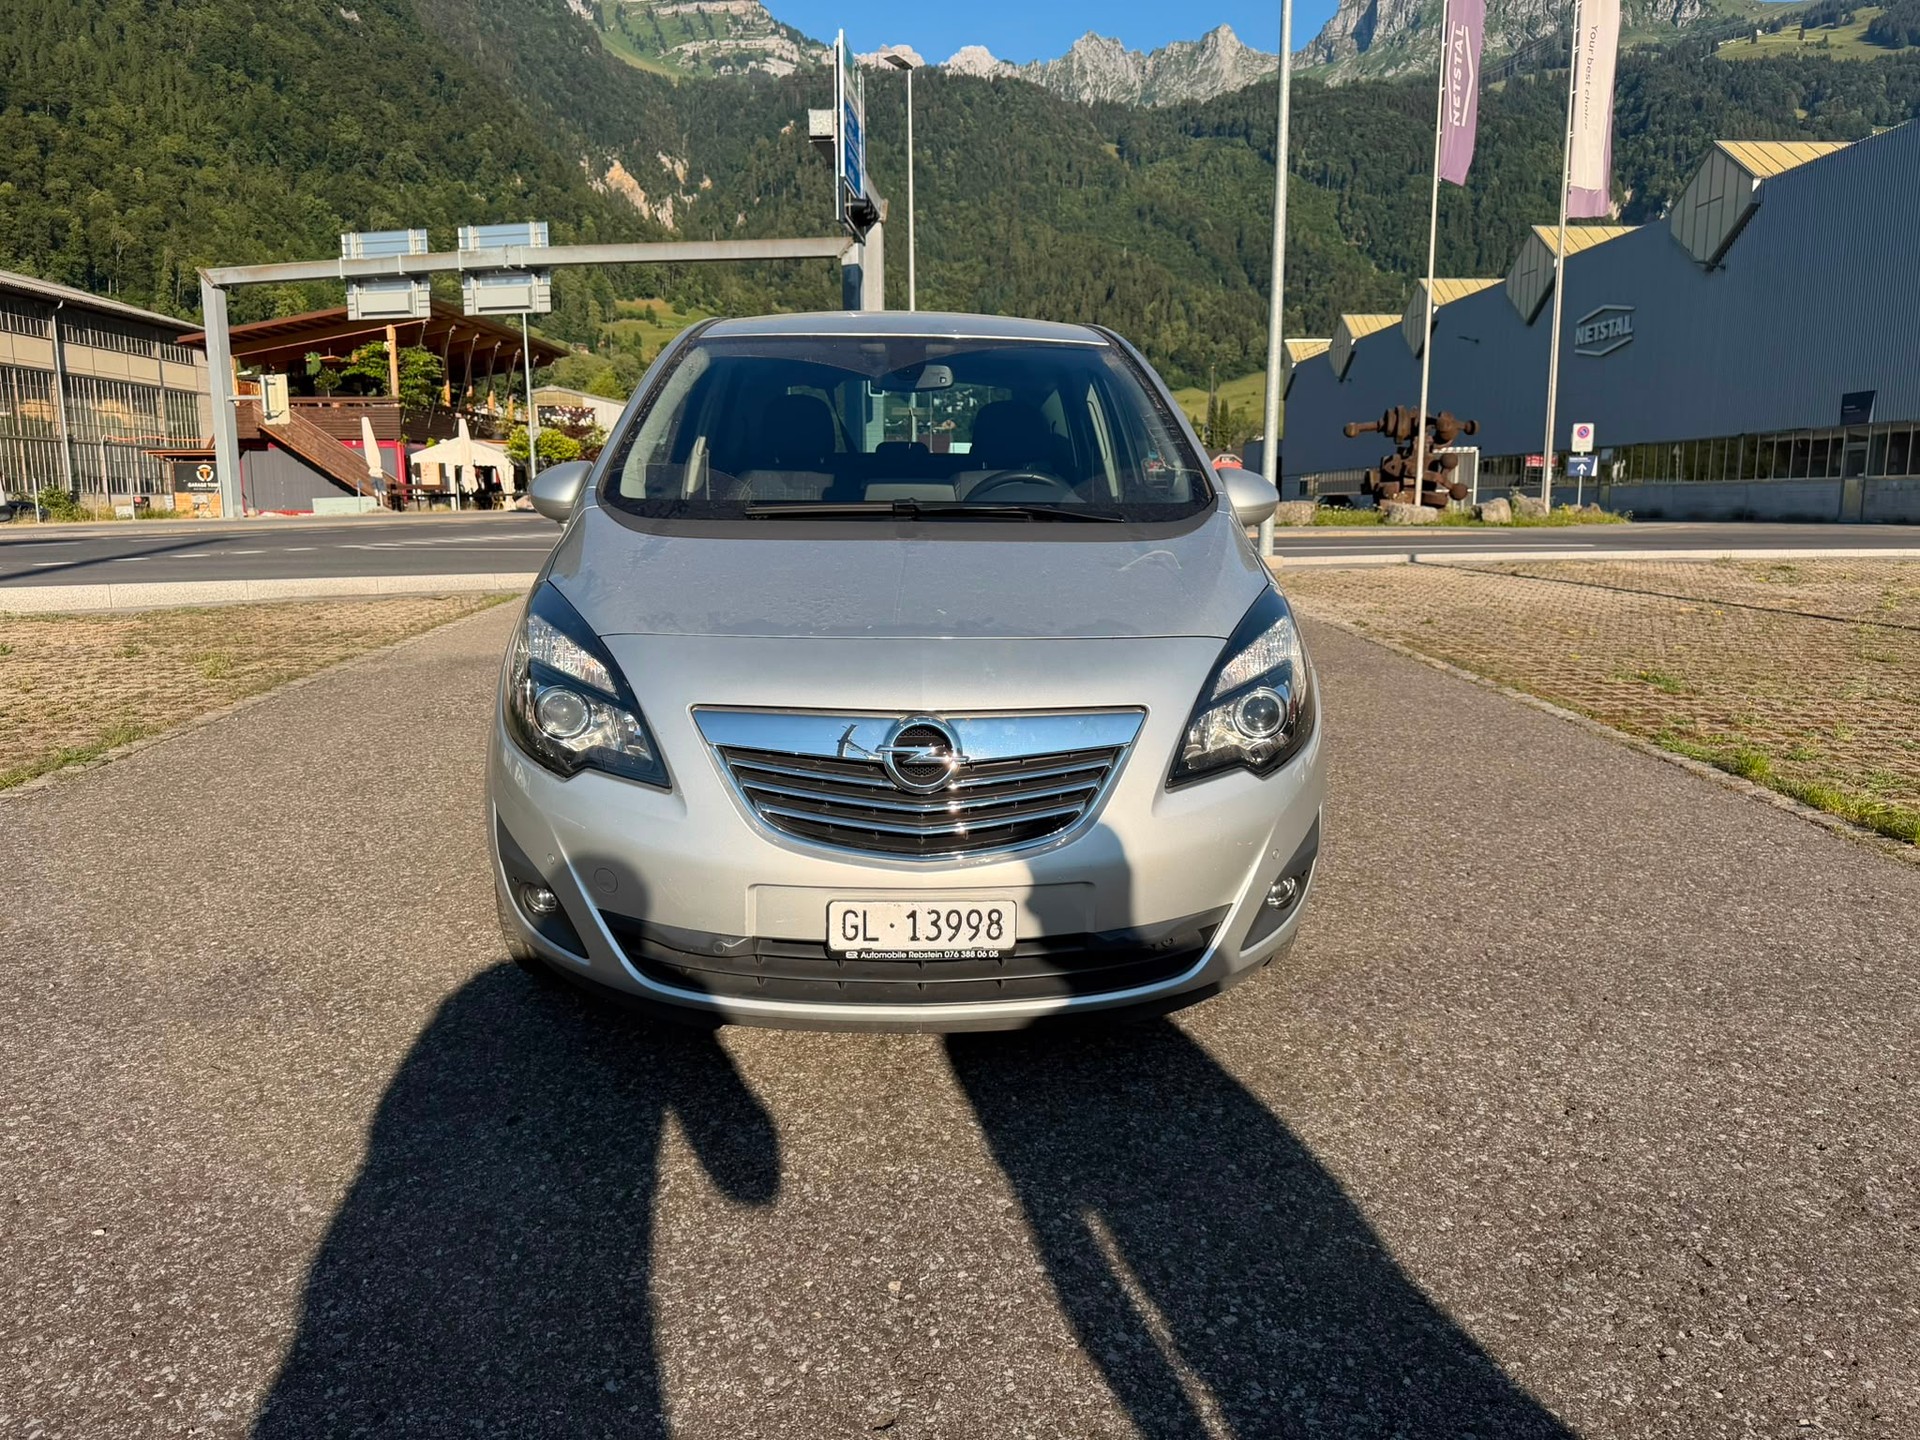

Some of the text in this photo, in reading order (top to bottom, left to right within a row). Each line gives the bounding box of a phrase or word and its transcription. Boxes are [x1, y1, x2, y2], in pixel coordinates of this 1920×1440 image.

[1589, 25, 1598, 55] Your
[1453, 25, 1465, 127] NETSTAL
[1585, 57, 1595, 84] best
[1575, 314, 1633, 346] NETSTAL
[842, 908, 1003, 943] GL 13998
[860, 951, 907, 959] Automobile
[908, 951, 943, 959] Rebstein
[944, 950, 959, 958] 076
[961, 950, 976, 958] 388
[977, 950, 988, 958] 06
[989, 950, 999, 958] 05
